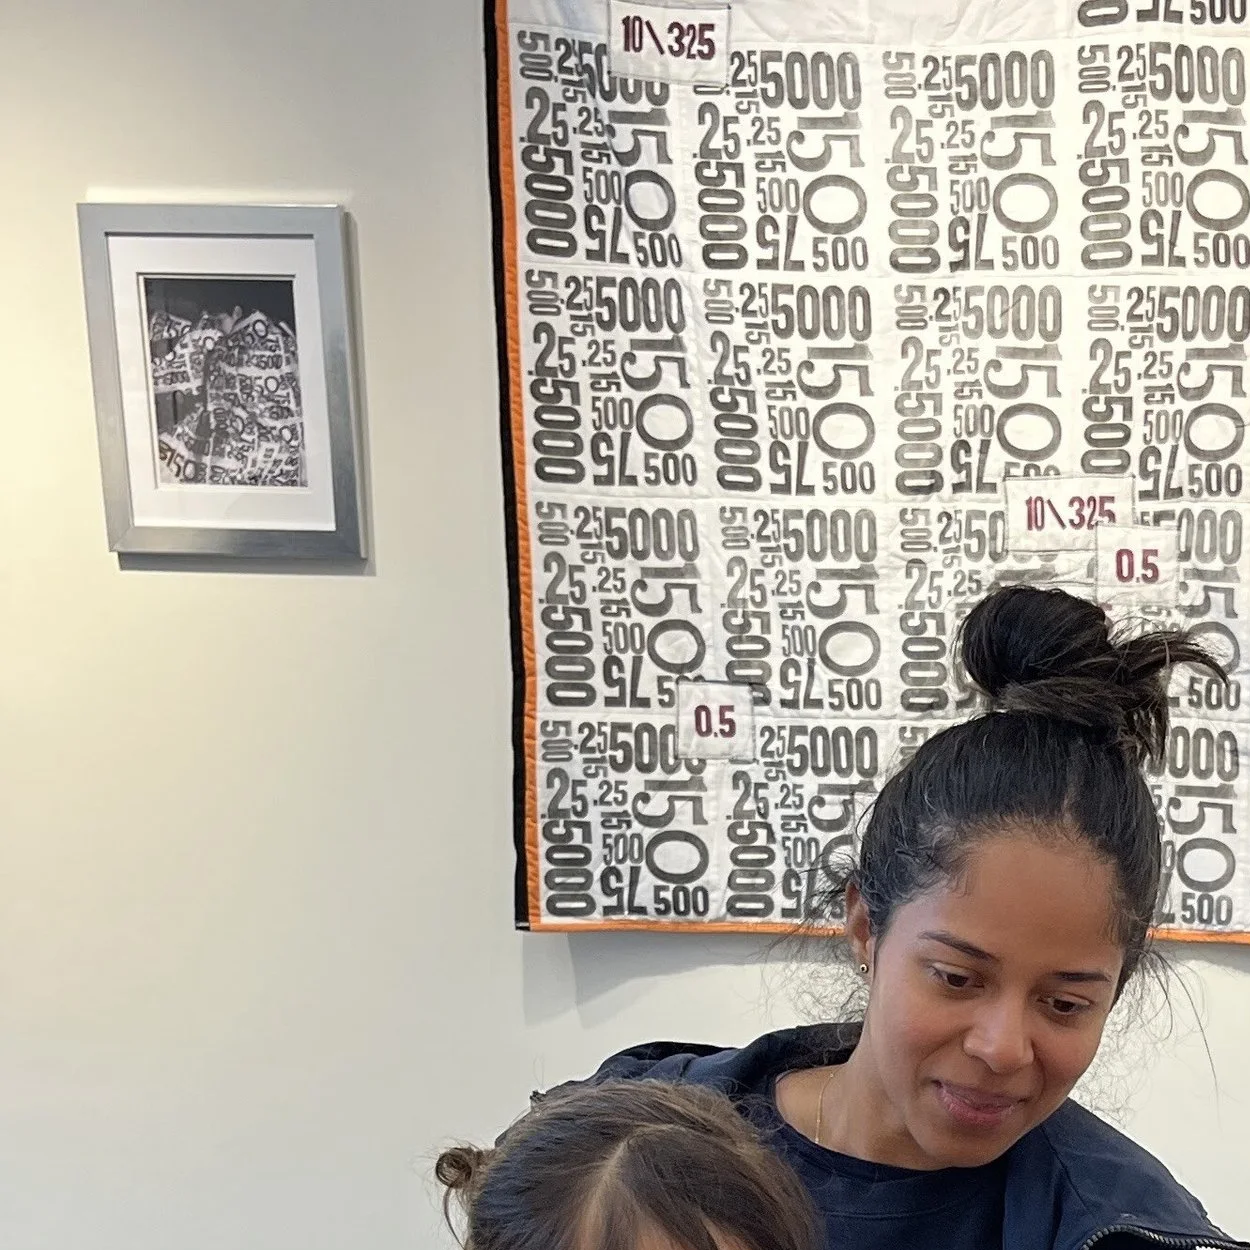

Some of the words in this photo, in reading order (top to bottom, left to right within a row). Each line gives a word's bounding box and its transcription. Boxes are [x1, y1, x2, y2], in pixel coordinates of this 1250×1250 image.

[760, 50, 862, 111] 5000
[955, 50, 1055, 111] 5000
[1149, 41, 1246, 106] 5000
[582, 166, 623, 206] 500
[756, 177, 800, 214] 500
[1142, 171, 1184, 208] 500
[632, 231, 683, 268] 500
[812, 236, 869, 272] 500
[1002, 235, 1059, 271] 500
[1194, 232, 1250, 269] 500
[595, 275, 686, 334] 5000
[771, 283, 872, 342] 5000
[962, 285, 1062, 342] 5000
[591, 396, 634, 431] 500
[953, 404, 995, 438] 500
[644, 451, 698, 487] 500
[822, 461, 875, 495] 500
[1188, 463, 1243, 503] 500
[604, 506, 700, 562] 5000
[782, 509, 877, 563] 5000
[1115, 548, 1160, 584] 0.5
[601, 621, 646, 655] 500
[828, 677, 882, 712] 500
[694, 704, 736, 738] 0.5
[785, 725, 881, 779] 5000
[602, 832, 645, 866] 500
[653, 885, 710, 920] 500
[1180, 892, 1233, 927] 500
